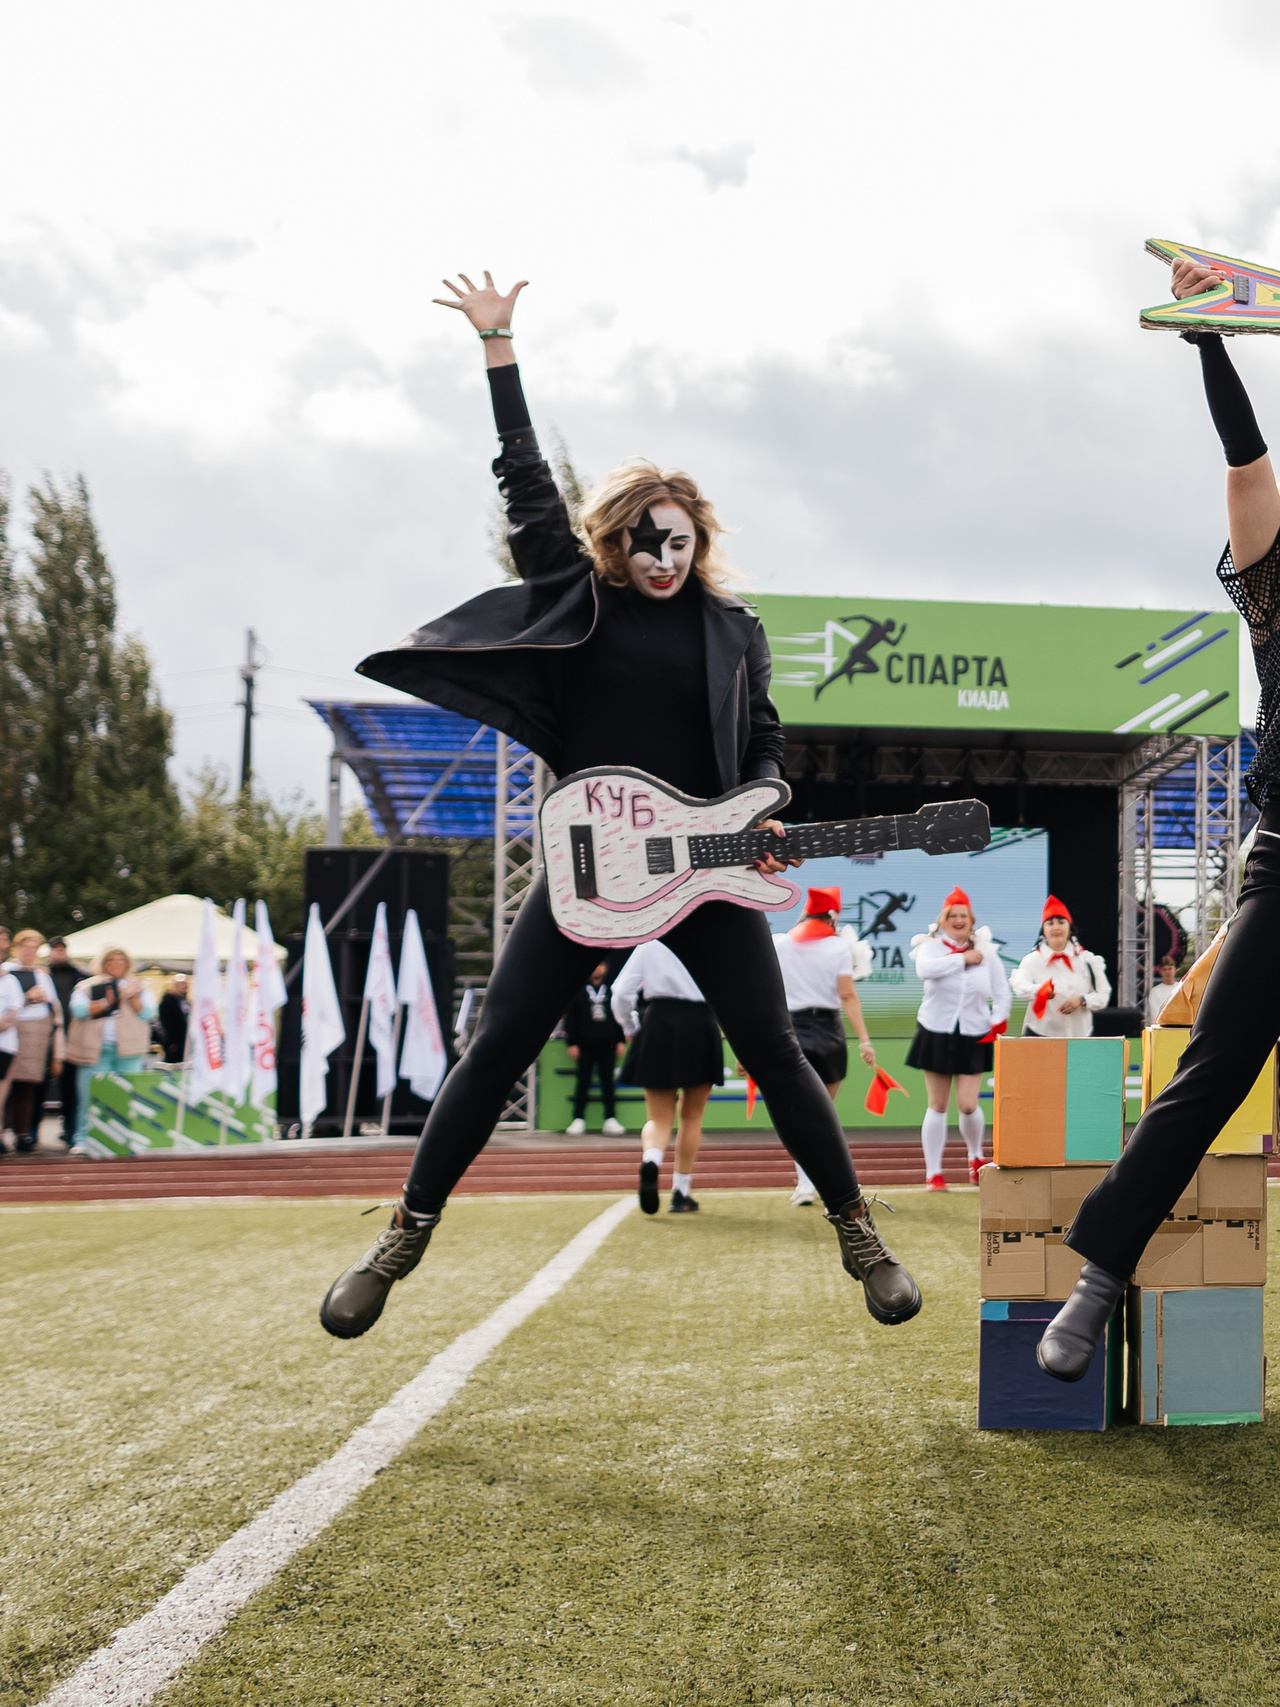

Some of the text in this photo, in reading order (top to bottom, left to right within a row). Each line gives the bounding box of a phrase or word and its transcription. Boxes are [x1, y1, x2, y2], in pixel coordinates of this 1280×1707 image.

[886, 652, 1008, 687] СПАРТА
[957, 688, 1010, 711] КИАДА
[584, 780, 656, 829] КУБ
